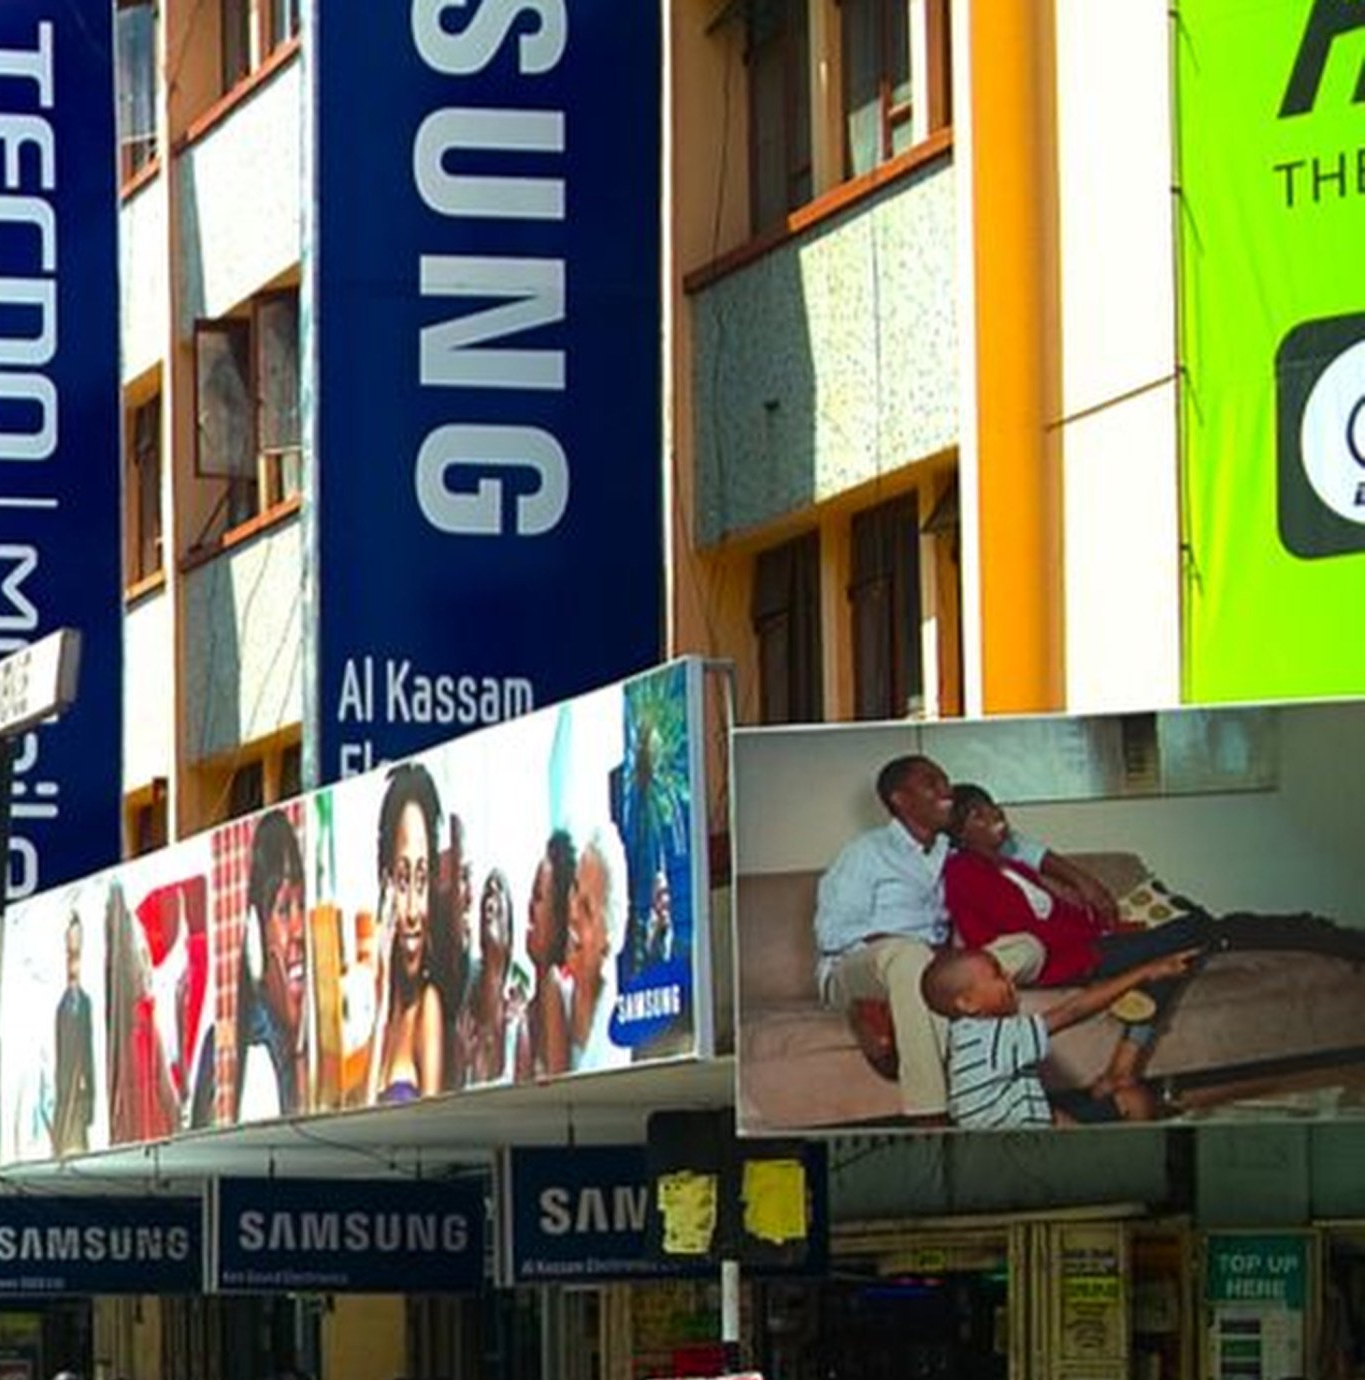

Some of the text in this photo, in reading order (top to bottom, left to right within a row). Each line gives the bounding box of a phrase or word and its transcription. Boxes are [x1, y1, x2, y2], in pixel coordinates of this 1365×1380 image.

[338, 655, 533, 724] Al Kassam
[616, 984, 680, 1023] SAMSUNG
[237, 1208, 469, 1252] SAMSUNG
[1214, 1253, 1299, 1274] TOP UP
[1226, 1278, 1288, 1298] HERE
